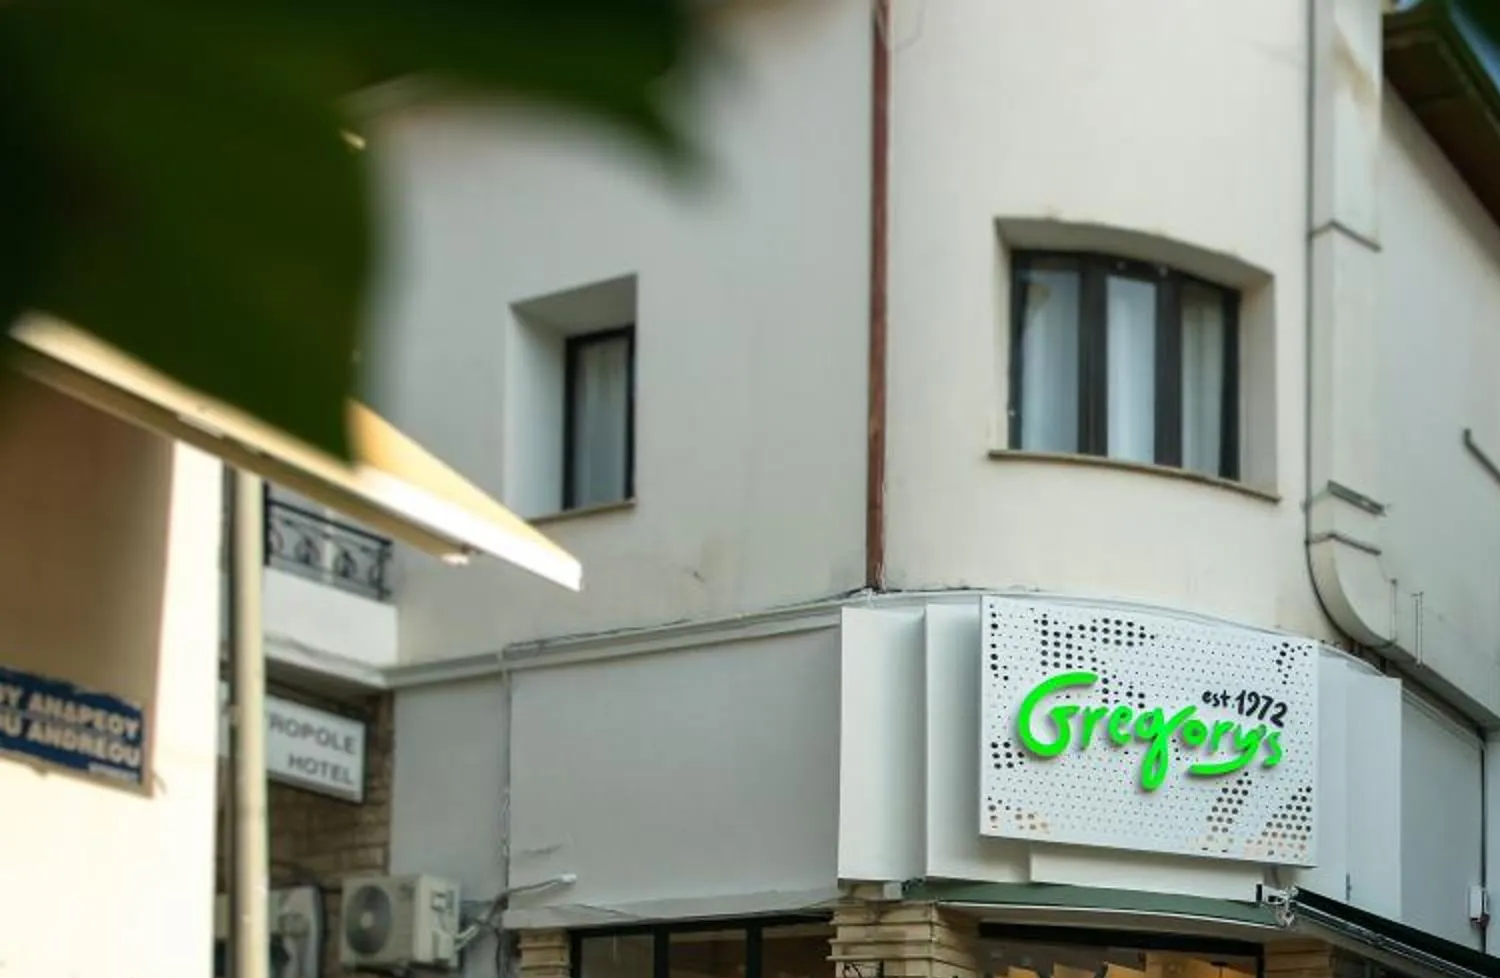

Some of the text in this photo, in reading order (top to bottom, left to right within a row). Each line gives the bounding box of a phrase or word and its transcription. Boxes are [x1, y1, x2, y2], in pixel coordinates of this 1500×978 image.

[1202, 690, 1288, 728] est 1972
[269, 712, 357, 756] ROPOLE
[288, 752, 355, 785] HOTEL
